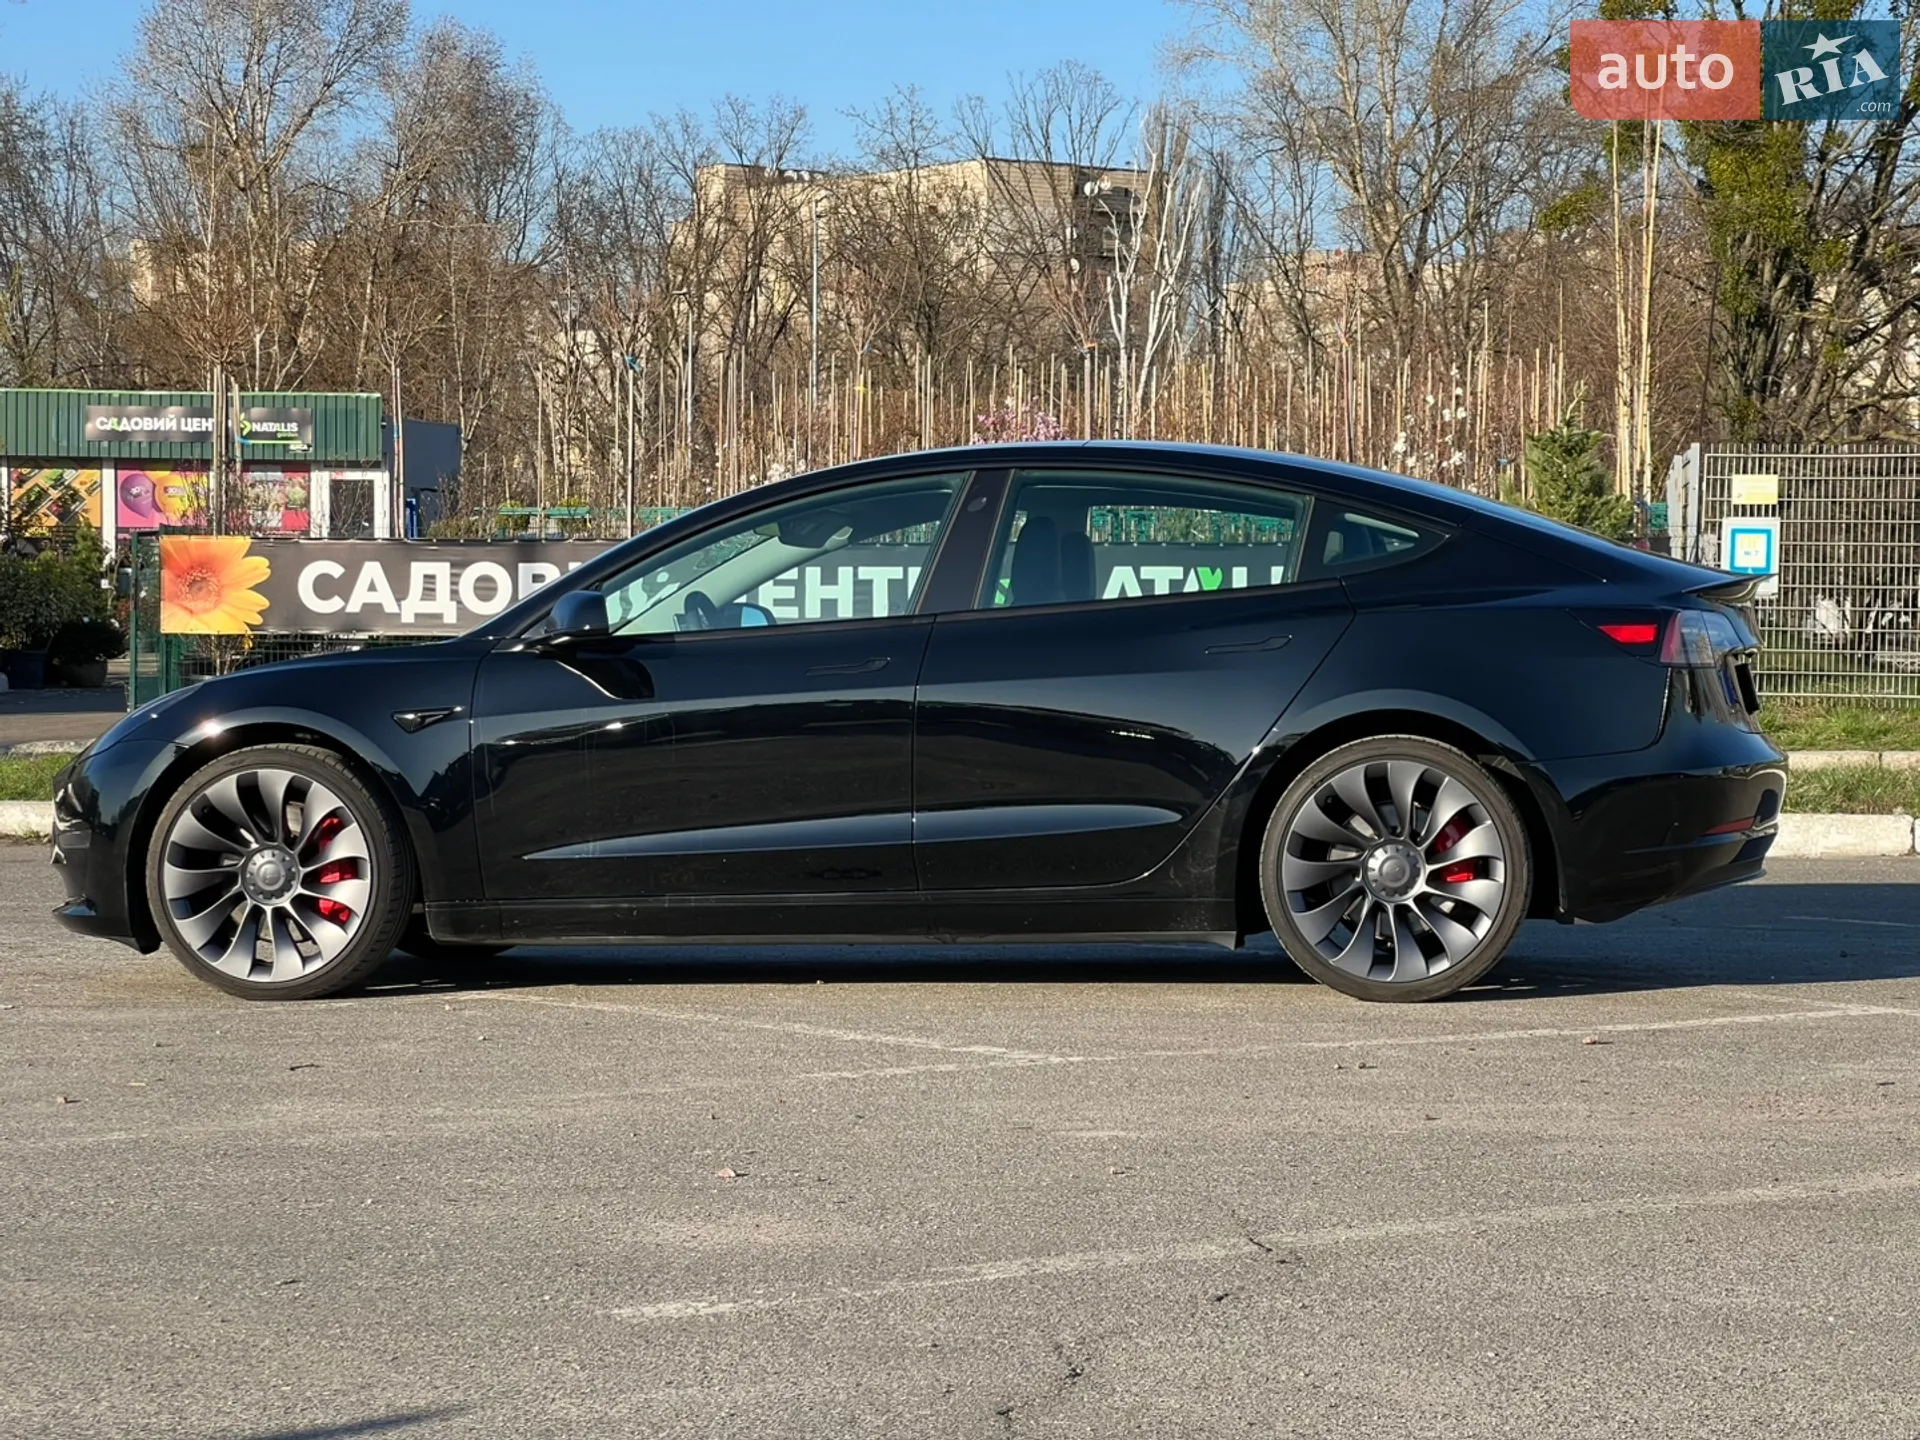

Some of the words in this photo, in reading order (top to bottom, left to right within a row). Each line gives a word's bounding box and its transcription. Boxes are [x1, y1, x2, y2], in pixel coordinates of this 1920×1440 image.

[95, 414, 177, 432] САДОВИЙ
[252, 421, 299, 432] NATALIS
[734, 566, 923, 619] ЕНТ
